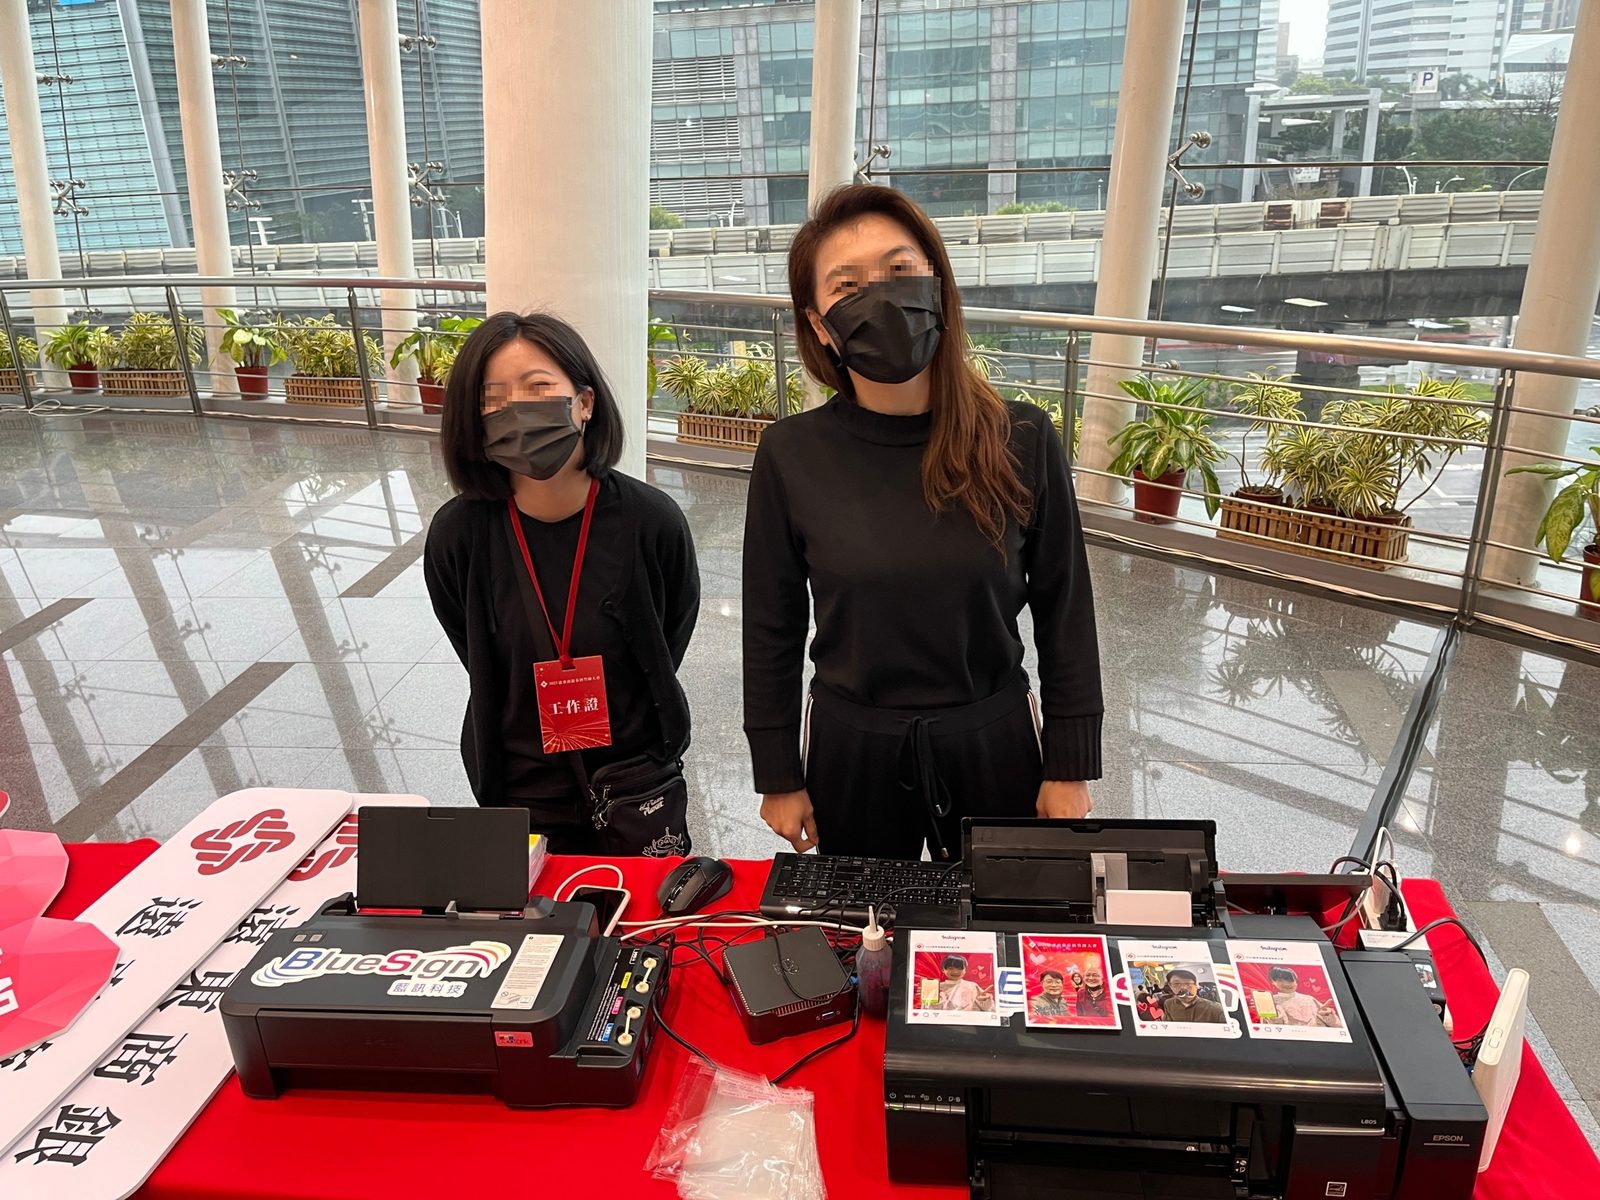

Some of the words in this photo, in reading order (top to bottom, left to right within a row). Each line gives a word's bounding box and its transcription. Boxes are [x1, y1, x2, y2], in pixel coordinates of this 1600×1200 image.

[551, 696, 598, 714] 工作證
[280, 950, 480, 979] BlueSign
[393, 982, 462, 994] 藍訊科技
